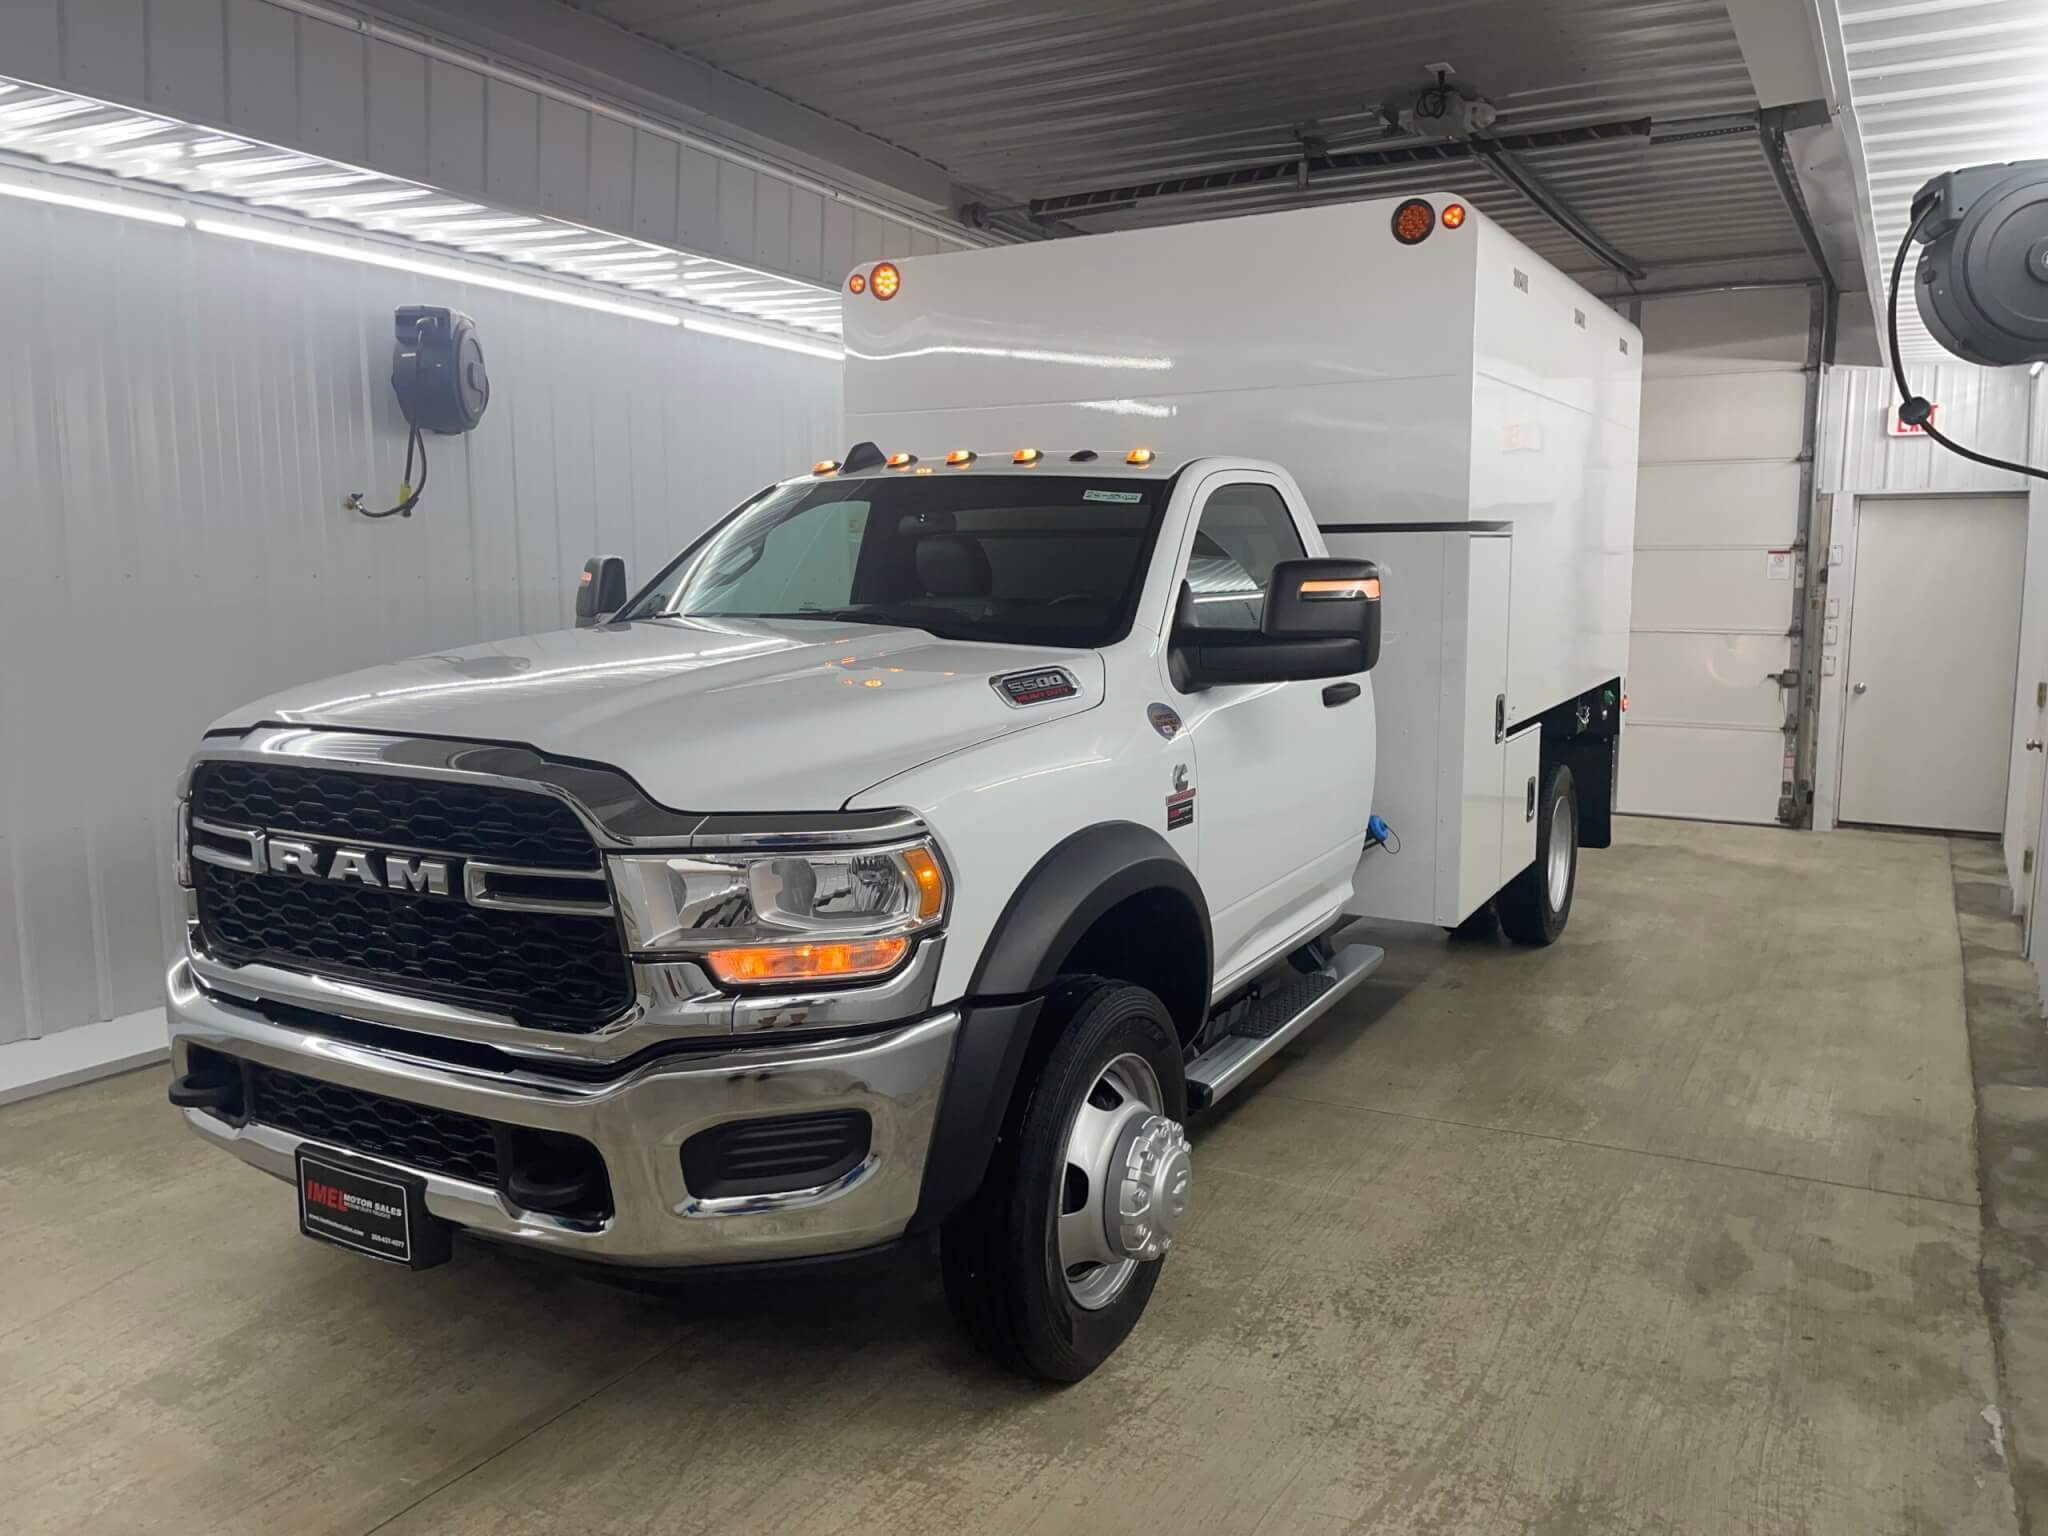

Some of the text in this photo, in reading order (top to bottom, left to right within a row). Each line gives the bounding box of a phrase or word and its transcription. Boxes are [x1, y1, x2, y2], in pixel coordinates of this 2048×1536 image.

[1008, 674, 1063, 692] 5500
[268, 838, 449, 896] RAM
[308, 1180, 402, 1217] IMEL MOTOR SALES
